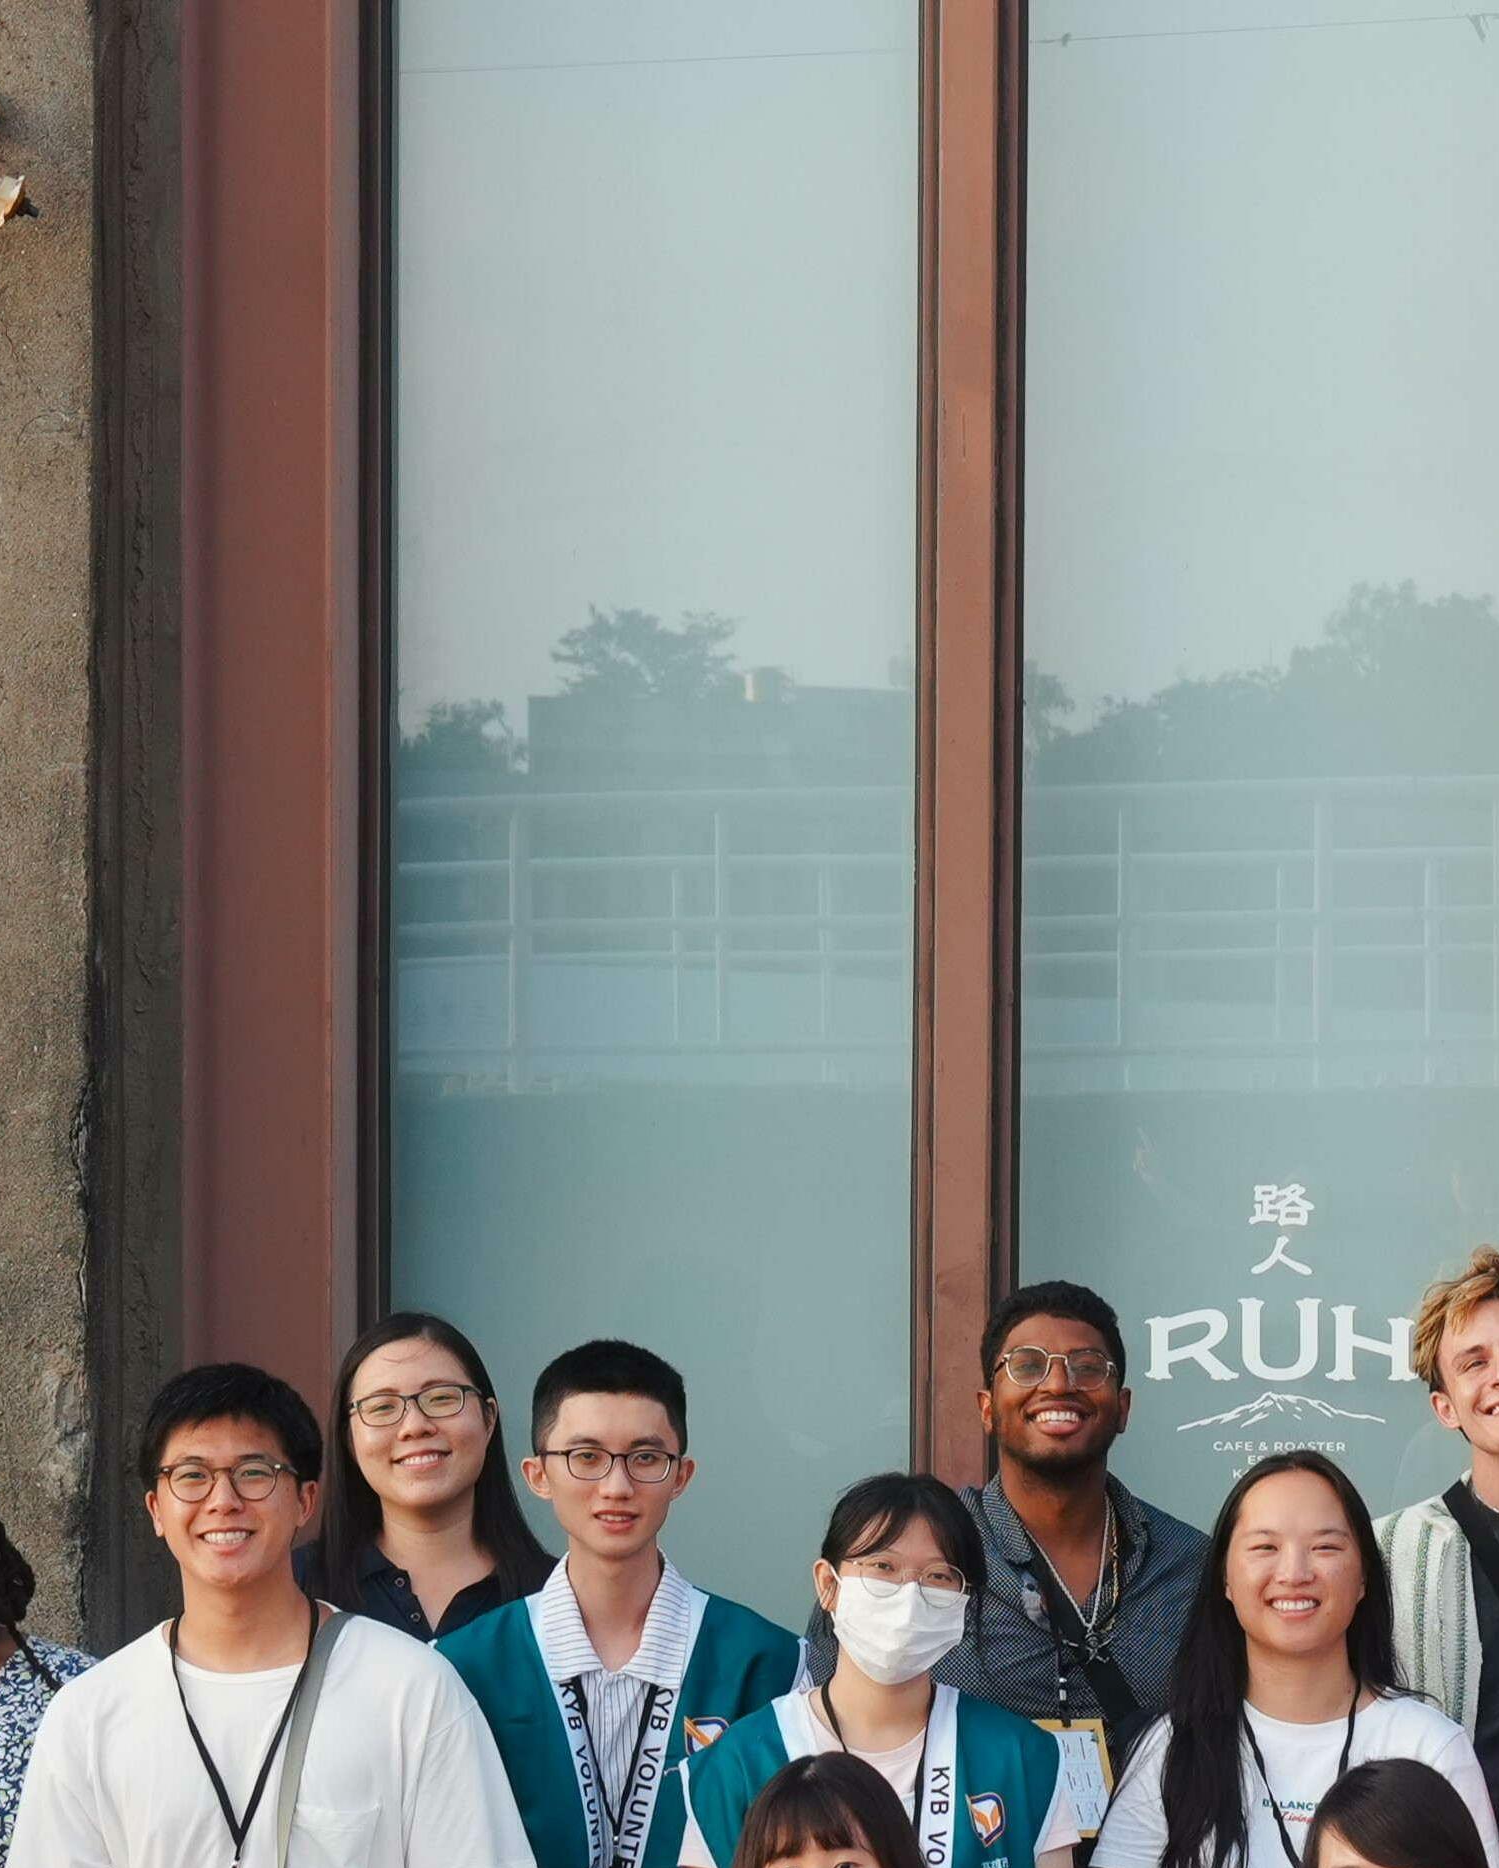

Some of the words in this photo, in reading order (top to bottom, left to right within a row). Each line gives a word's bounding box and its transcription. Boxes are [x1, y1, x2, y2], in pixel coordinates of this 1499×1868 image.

[1248, 1183, 1315, 1276] 路人
[1144, 1297, 1419, 1382] RUH
[1212, 1440, 1254, 1452] CAFE
[1258, 1440, 1269, 1452] &
[1273, 1440, 1347, 1452] ROASTER
[929, 1765, 951, 1816] KYB
[1262, 1798, 1318, 1812] BLANC
